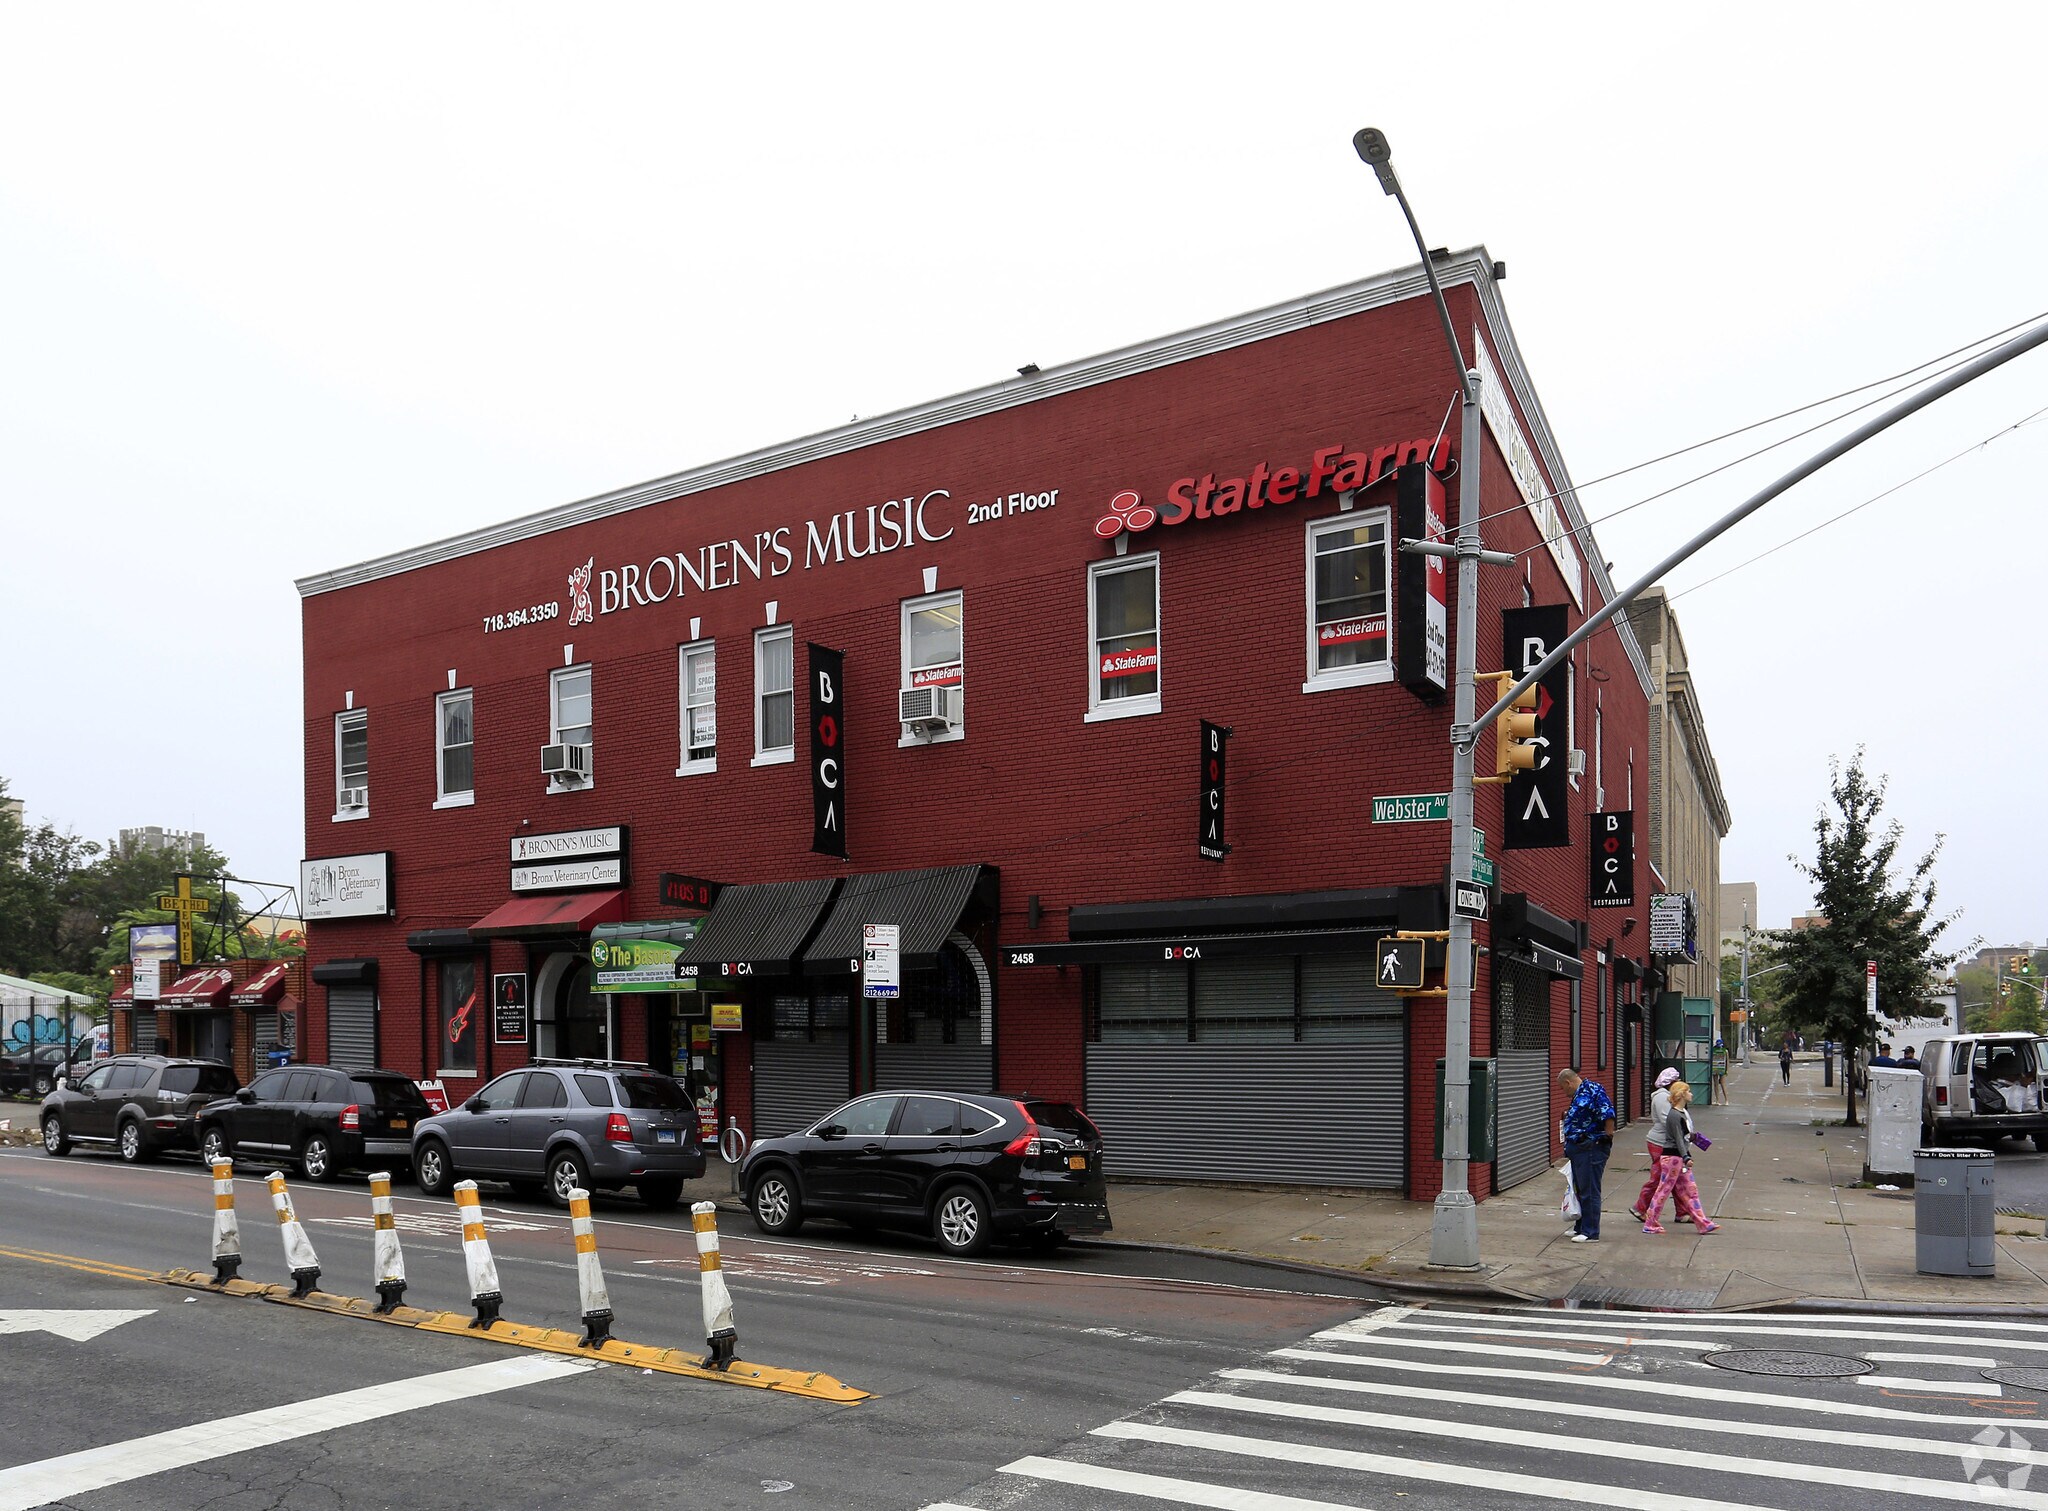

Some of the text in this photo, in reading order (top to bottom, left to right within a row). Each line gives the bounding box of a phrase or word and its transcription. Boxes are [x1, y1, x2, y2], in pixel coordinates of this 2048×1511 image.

[966, 488, 1059, 525] 2nd Floor
[600, 489, 954, 614] BRONEN'S MUSIC
[483, 601, 558, 634] 718.364.3350
[698, 675, 714, 686] SPACE
[818, 670, 838, 832] BOCA
[1208, 729, 1218, 840] BOCA
[1375, 796, 1446, 820] Webster Av
[528, 832, 612, 854] BRONEN'S MUSIC
[1603, 815, 1620, 894] BOCA
[338, 865, 360, 880] Bronx
[532, 866, 618, 885] Bronx Veterinary Center
[344, 877, 380, 891] Veterinary
[340, 887, 364, 902] Center
[1460, 892, 1484, 908] ONE WAY
[1594, 898, 1631, 906] RESTAURANT
[163, 898, 208, 911] BETHEL
[610, 946, 631, 967] The
[867, 950, 873, 960] 2
[1011, 953, 1034, 964] 2458
[1164, 946, 1201, 960] BOCA
[680, 966, 698, 976] 2458
[722, 962, 753, 976] BOCA
